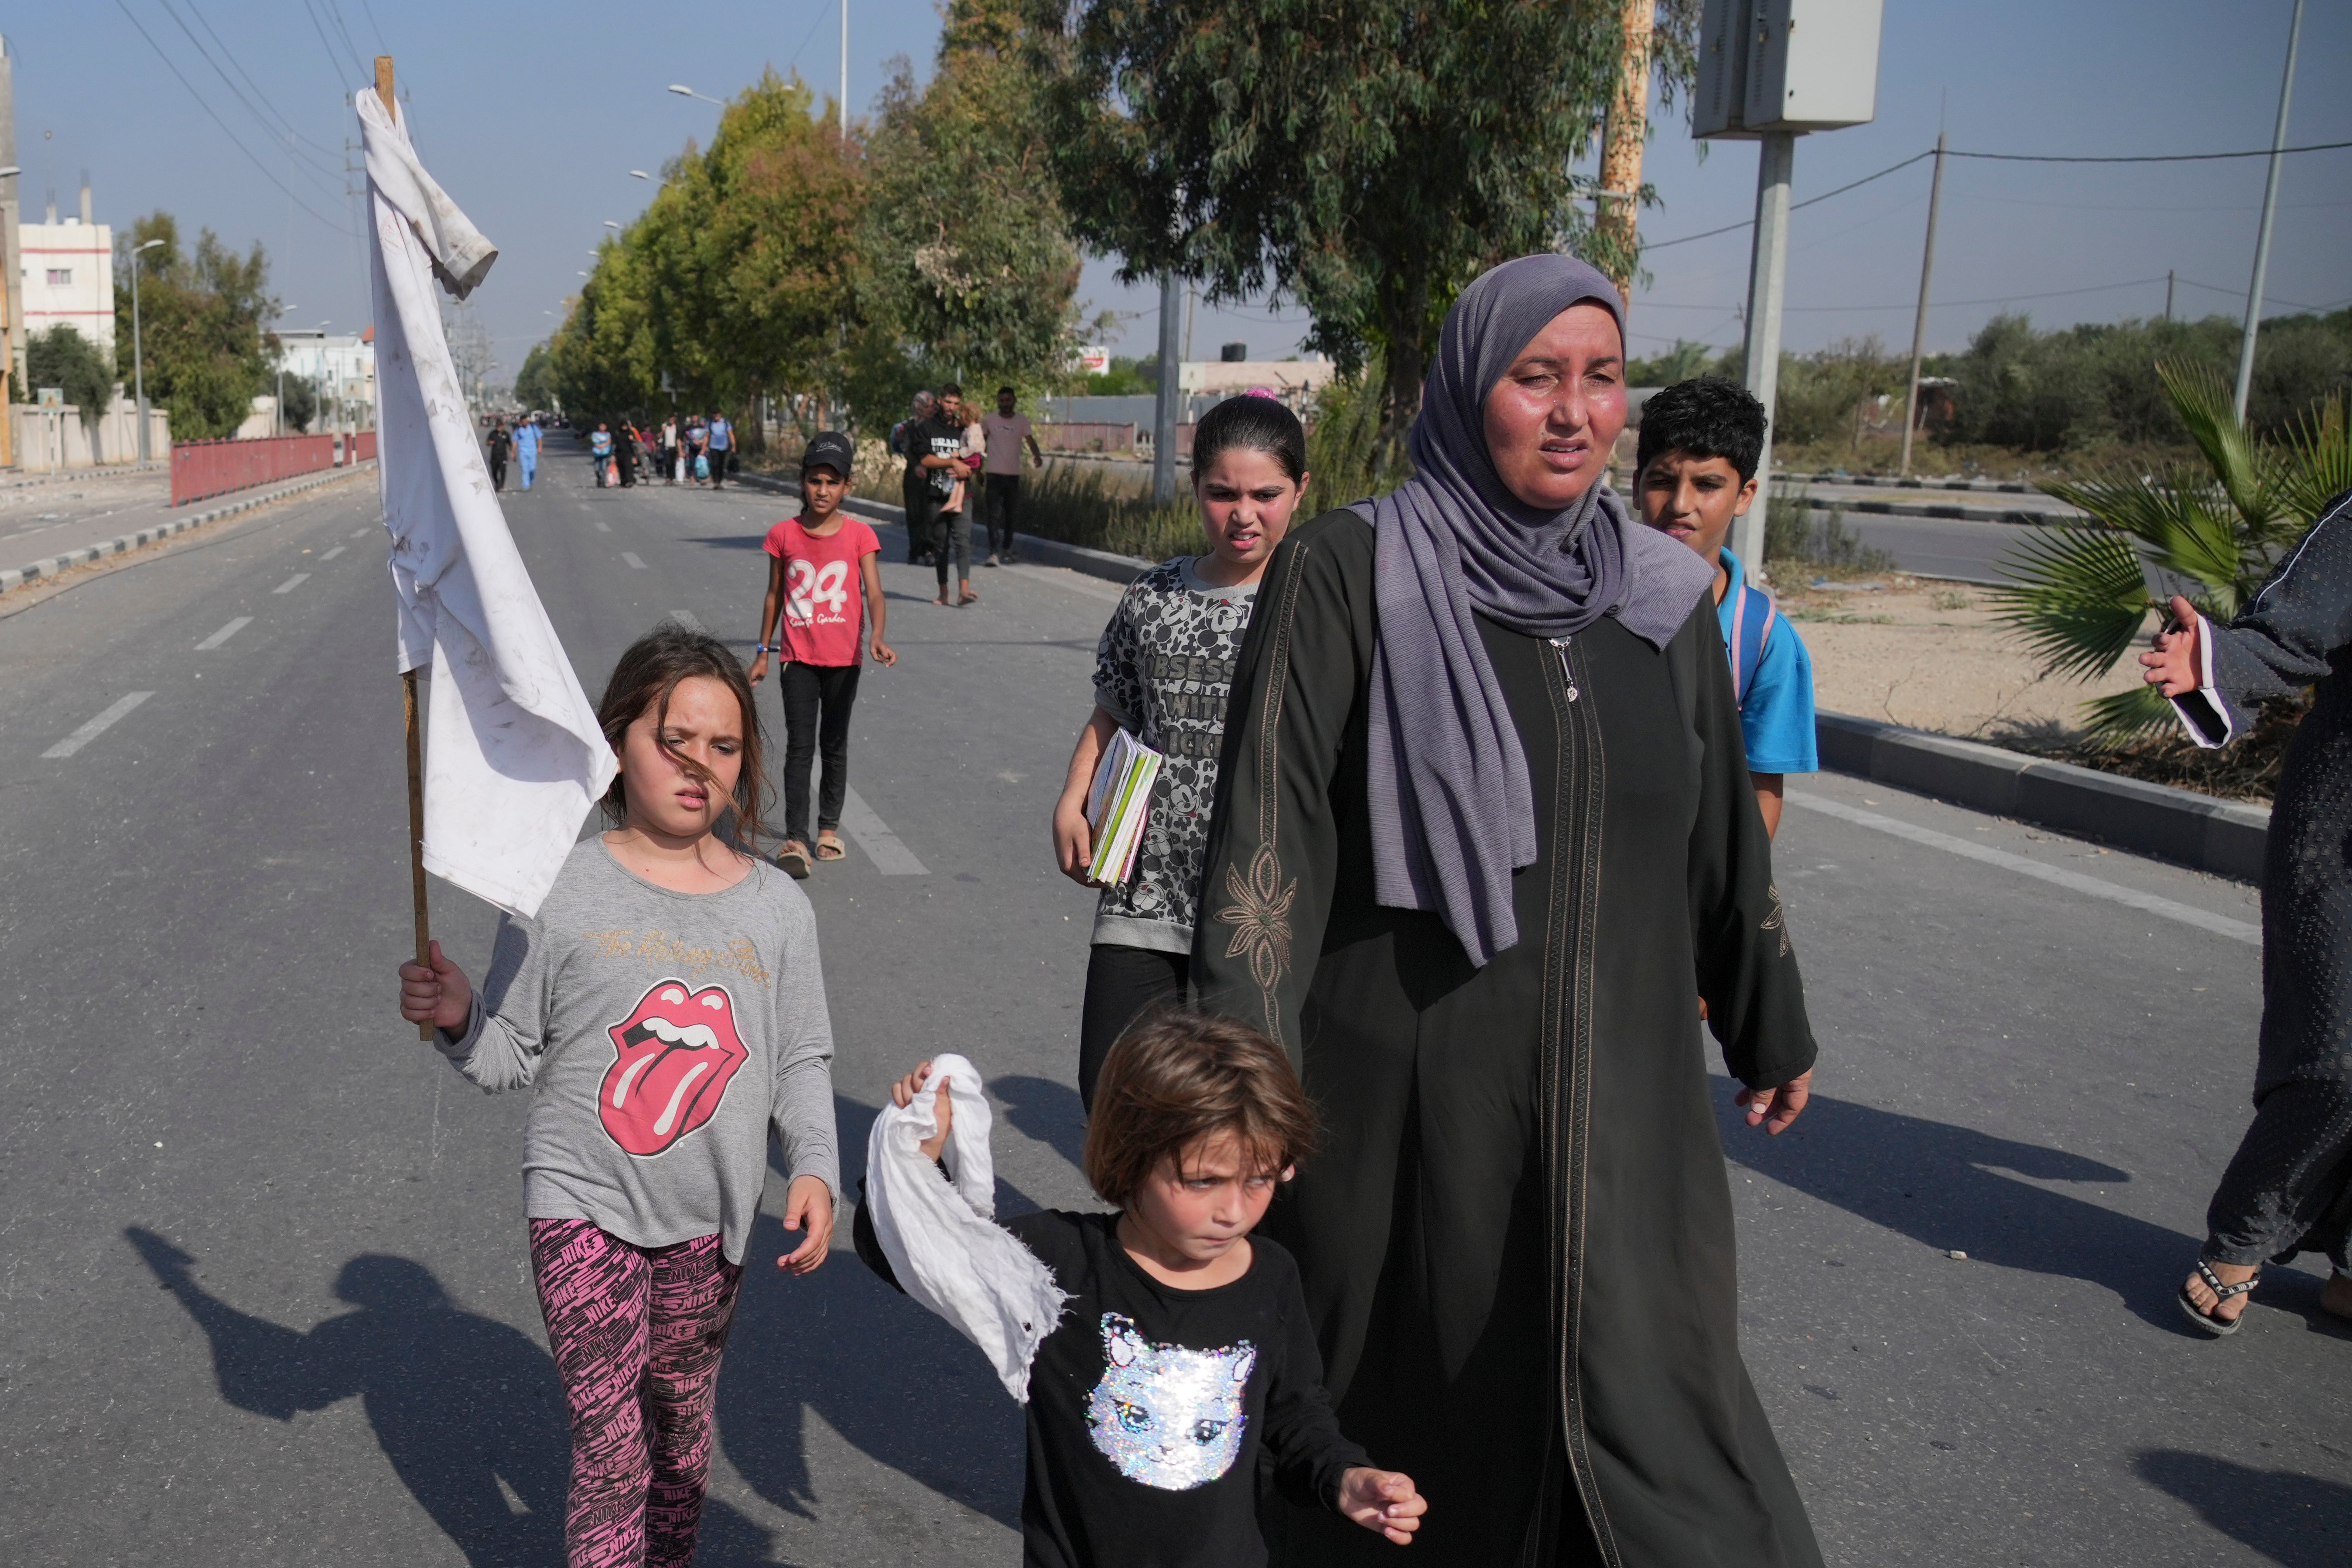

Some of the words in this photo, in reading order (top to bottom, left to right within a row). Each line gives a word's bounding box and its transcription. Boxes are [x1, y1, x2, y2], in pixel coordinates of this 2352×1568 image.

[786, 559, 848, 619] 24
[1162, 730, 1224, 758] ICK
[583, 929, 633, 958] The
[637, 929, 714, 981] Rolling
[561, 1237, 592, 1265] NIKE
[672, 1261, 704, 1282] NIKE
[550, 1281, 577, 1309] NIKE
[682, 1288, 716, 1309] NIKE
[585, 1294, 616, 1325] NIKE
[581, 1332, 612, 1363] NIKE
[612, 1358, 636, 1390] NIKE
[675, 1374, 704, 1394] NIKE
[571, 1387, 596, 1411] NIKE
[604, 1413, 636, 1442] NIKE
[588, 1461, 615, 1477] NIKE
[677, 1448, 703, 1469] NIKE
[664, 1488, 692, 1500] NIKE
[592, 1499, 625, 1526] NIKE
[668, 1507, 697, 1524] NIKE
[610, 1527, 636, 1556] NIKE
